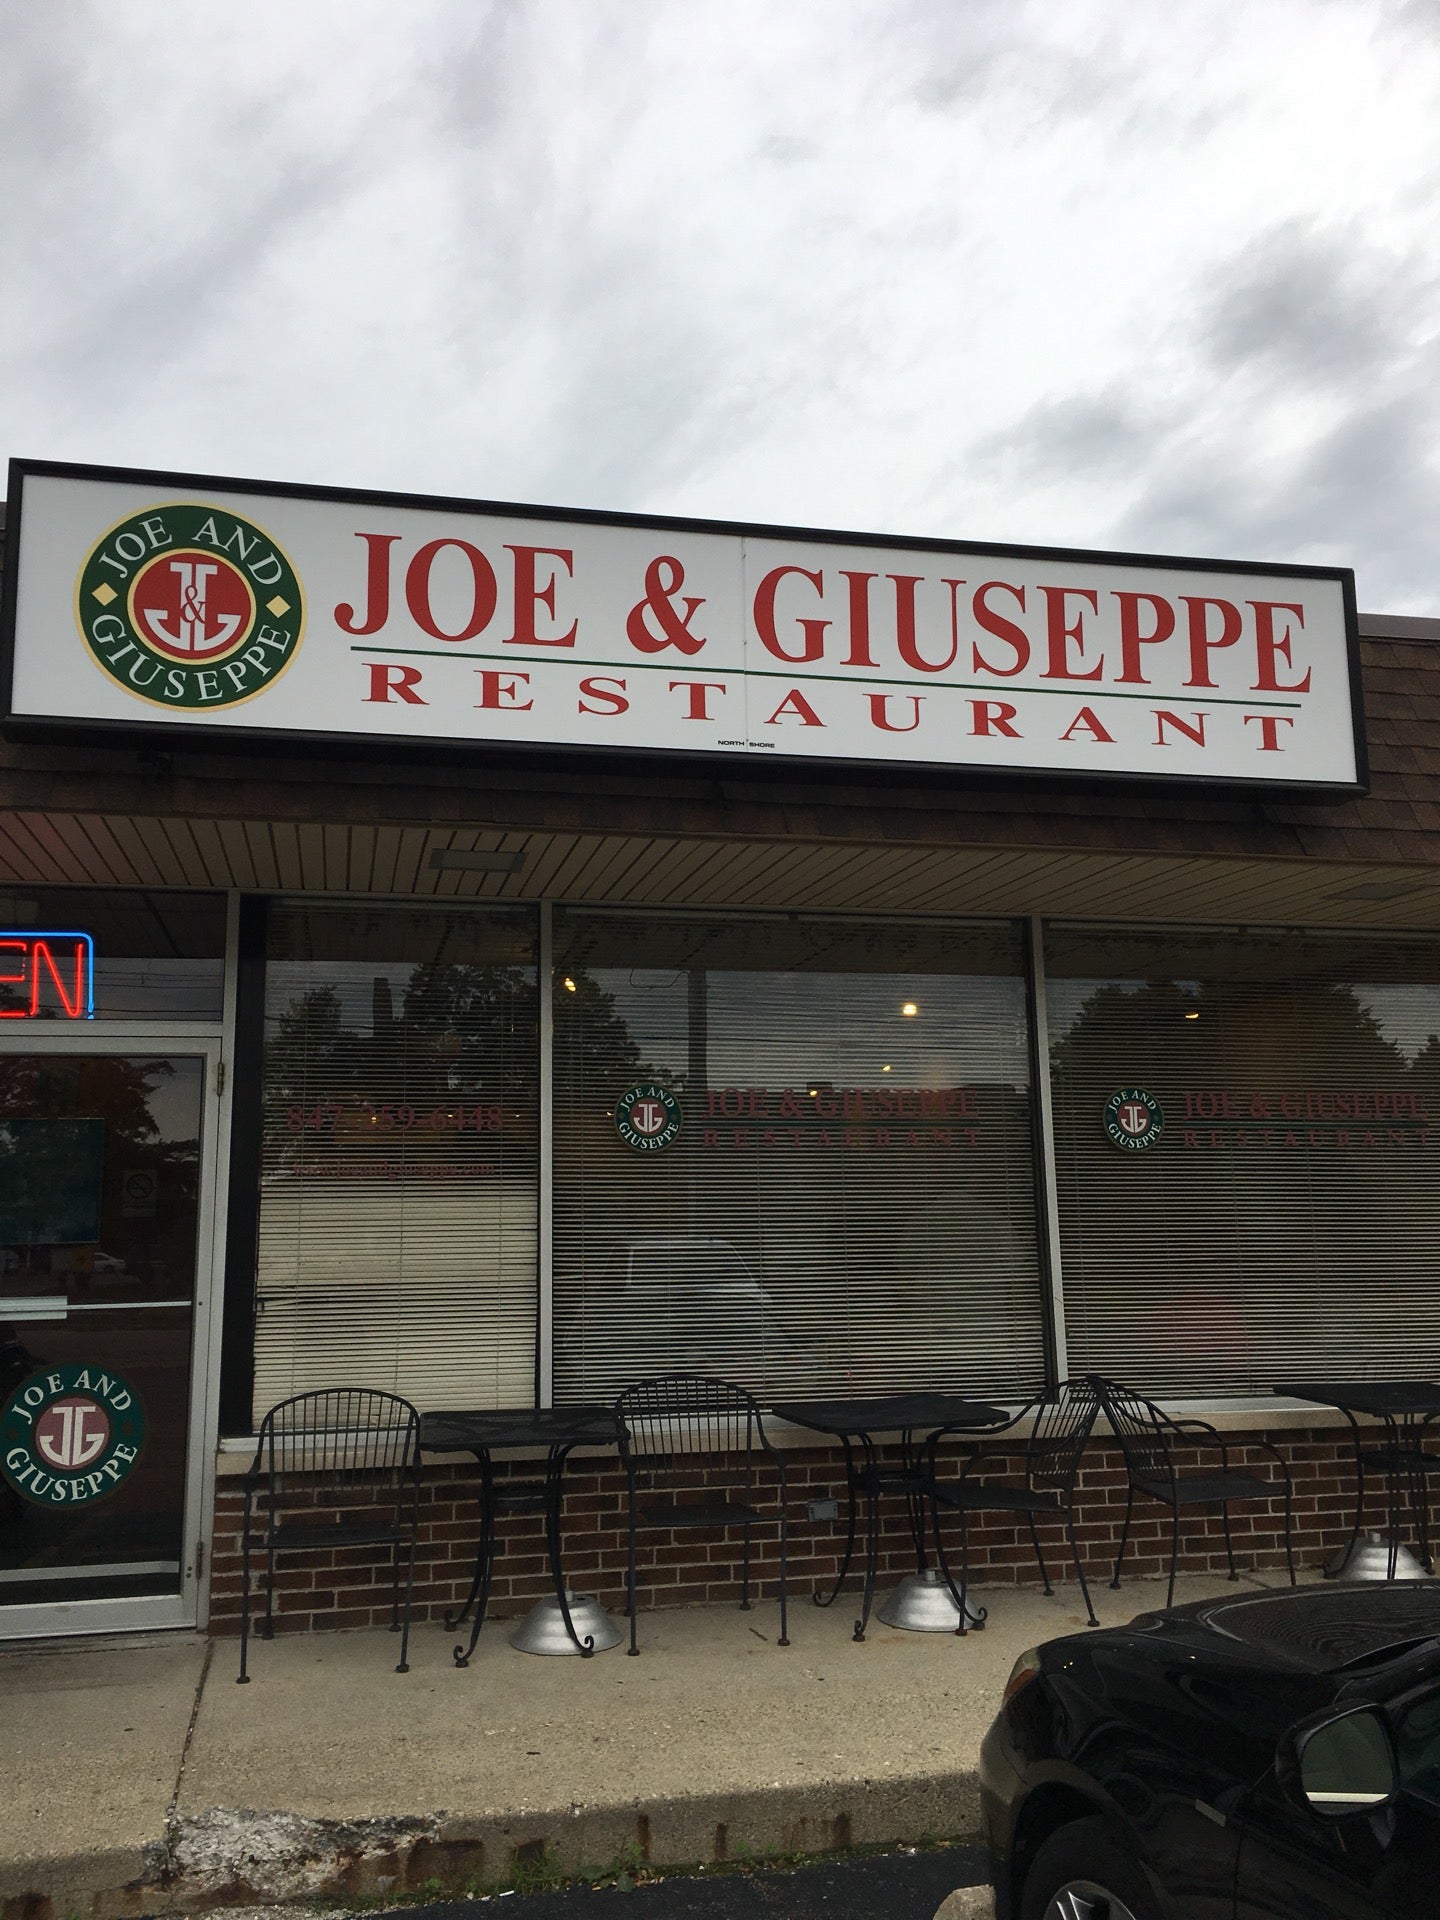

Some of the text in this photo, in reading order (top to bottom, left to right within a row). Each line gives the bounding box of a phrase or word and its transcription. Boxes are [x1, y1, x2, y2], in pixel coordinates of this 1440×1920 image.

[97, 516, 283, 586] JOE AND
[334, 532, 1312, 693] JOE & GIUSEPPE
[91, 614, 292, 701] GIUSEPPE
[361, 663, 1294, 751] RESTAURANT
[619, 1086, 676, 1113] JOE AND
[703, 1087, 981, 1119] JOE & GIUSEPPE
[1107, 1089, 1158, 1114] JOE AND
[1182, 1090, 1428, 1122] JOE & GIUSEPPE
[286, 1104, 503, 1132] 847-259-6448
[618, 1121, 680, 1150] GIUSEPPE
[703, 1127, 981, 1148] RESTAURANT
[1107, 1121, 1162, 1150] GIUSEPPE
[1182, 1127, 1432, 1148] RESTAURANT
[12, 1369, 132, 1426] JOE AND
[6, 1442, 139, 1502] GIUSEPPE
